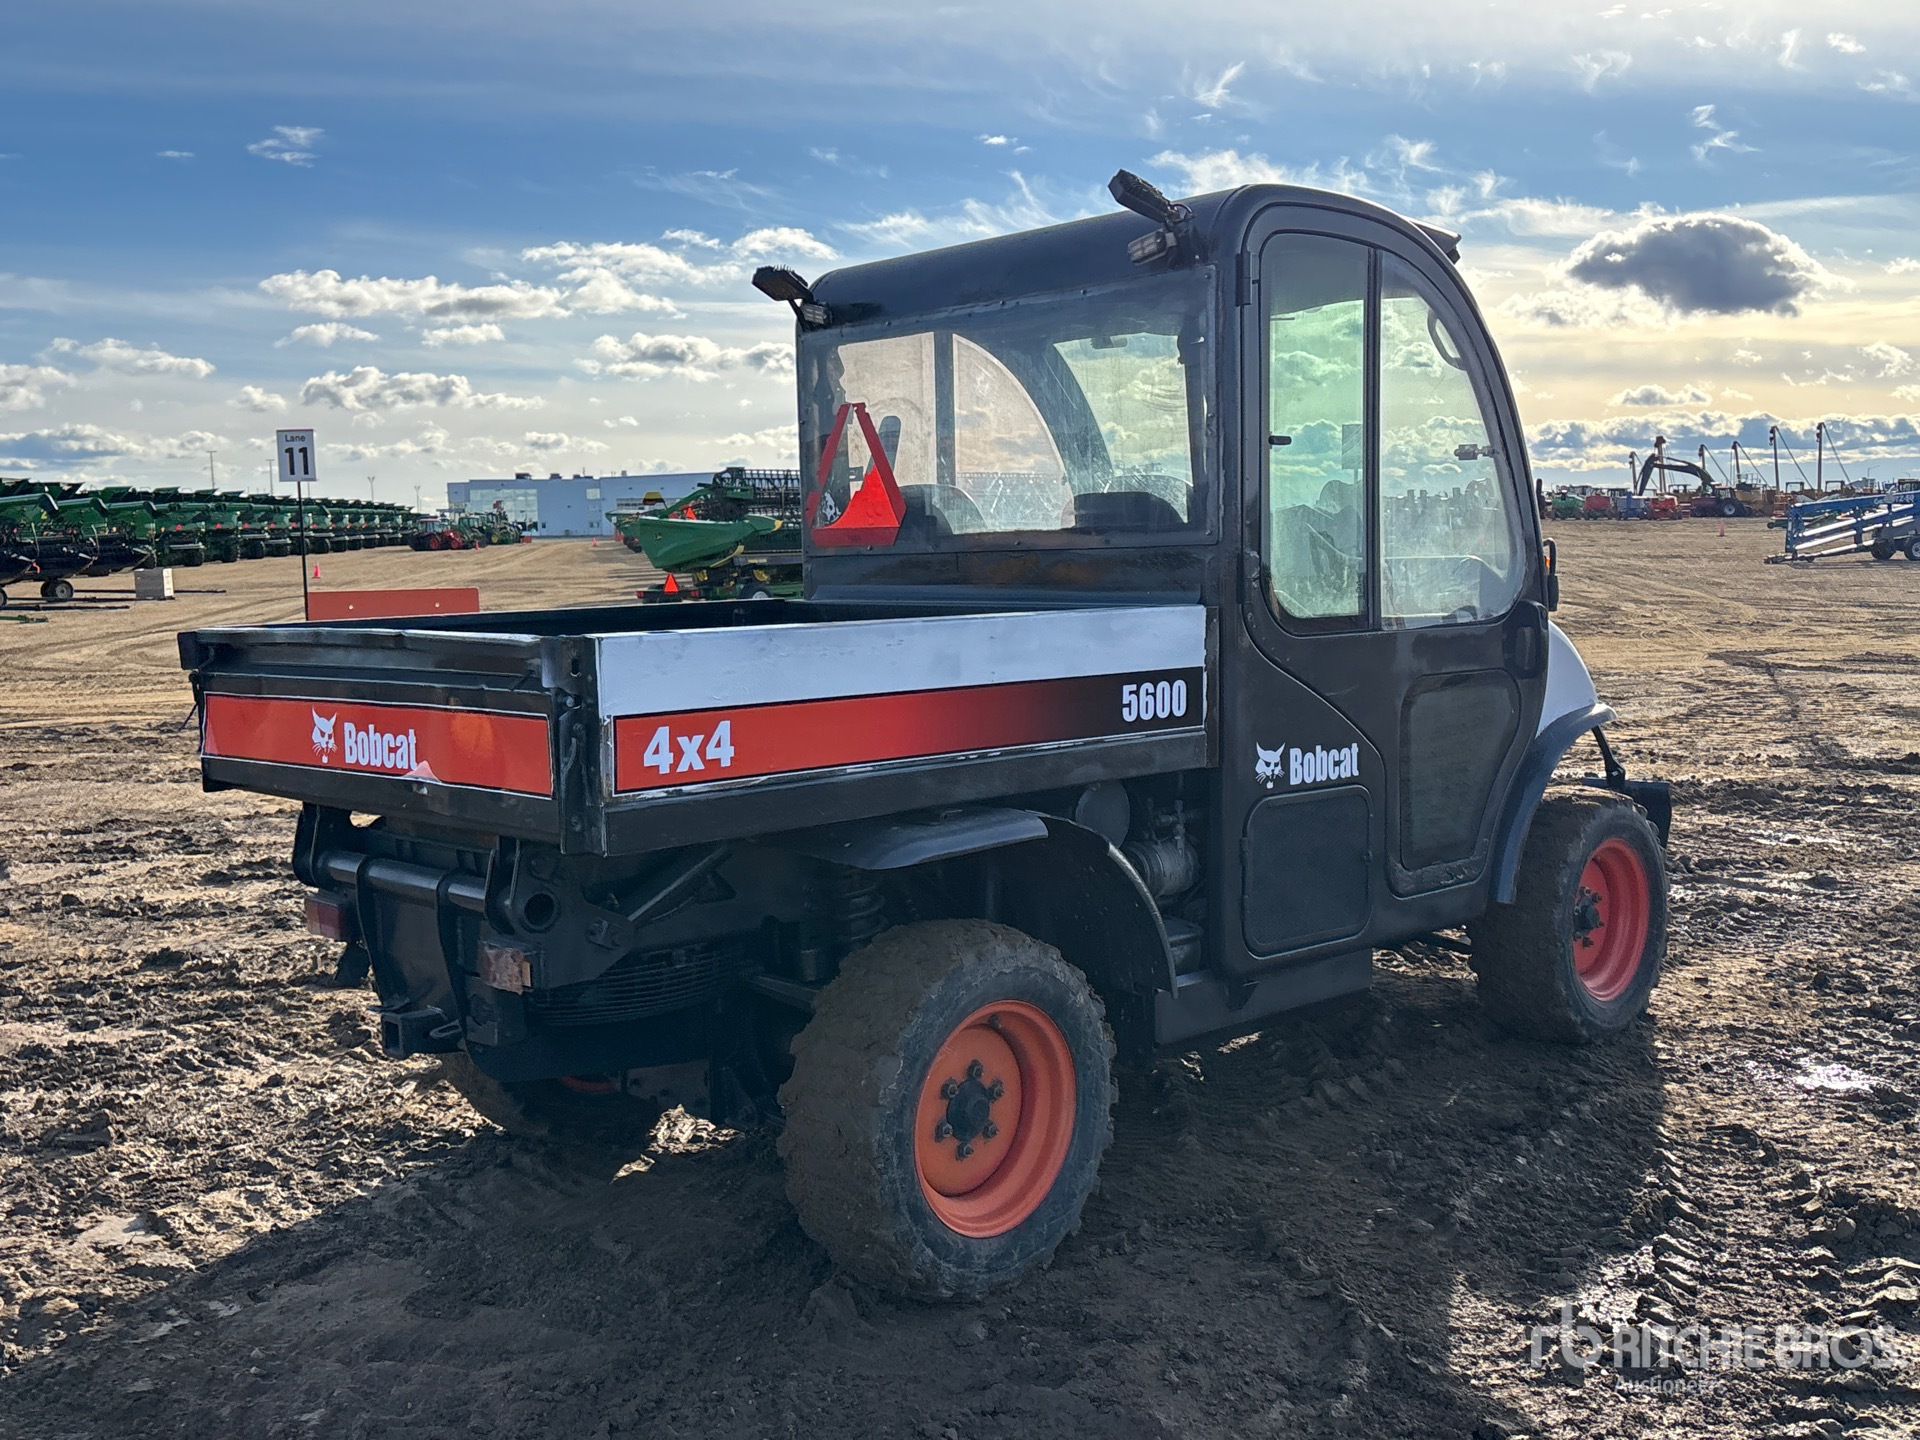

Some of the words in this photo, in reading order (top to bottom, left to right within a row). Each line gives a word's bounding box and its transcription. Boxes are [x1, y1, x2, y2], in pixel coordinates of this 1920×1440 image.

[285, 434, 306, 442] Lane
[285, 447, 309, 475] 11
[1121, 679, 1187, 724] 5600
[344, 722, 418, 771] Bobcat
[643, 720, 735, 775] 4x4
[1289, 742, 1360, 786] Bobcat
